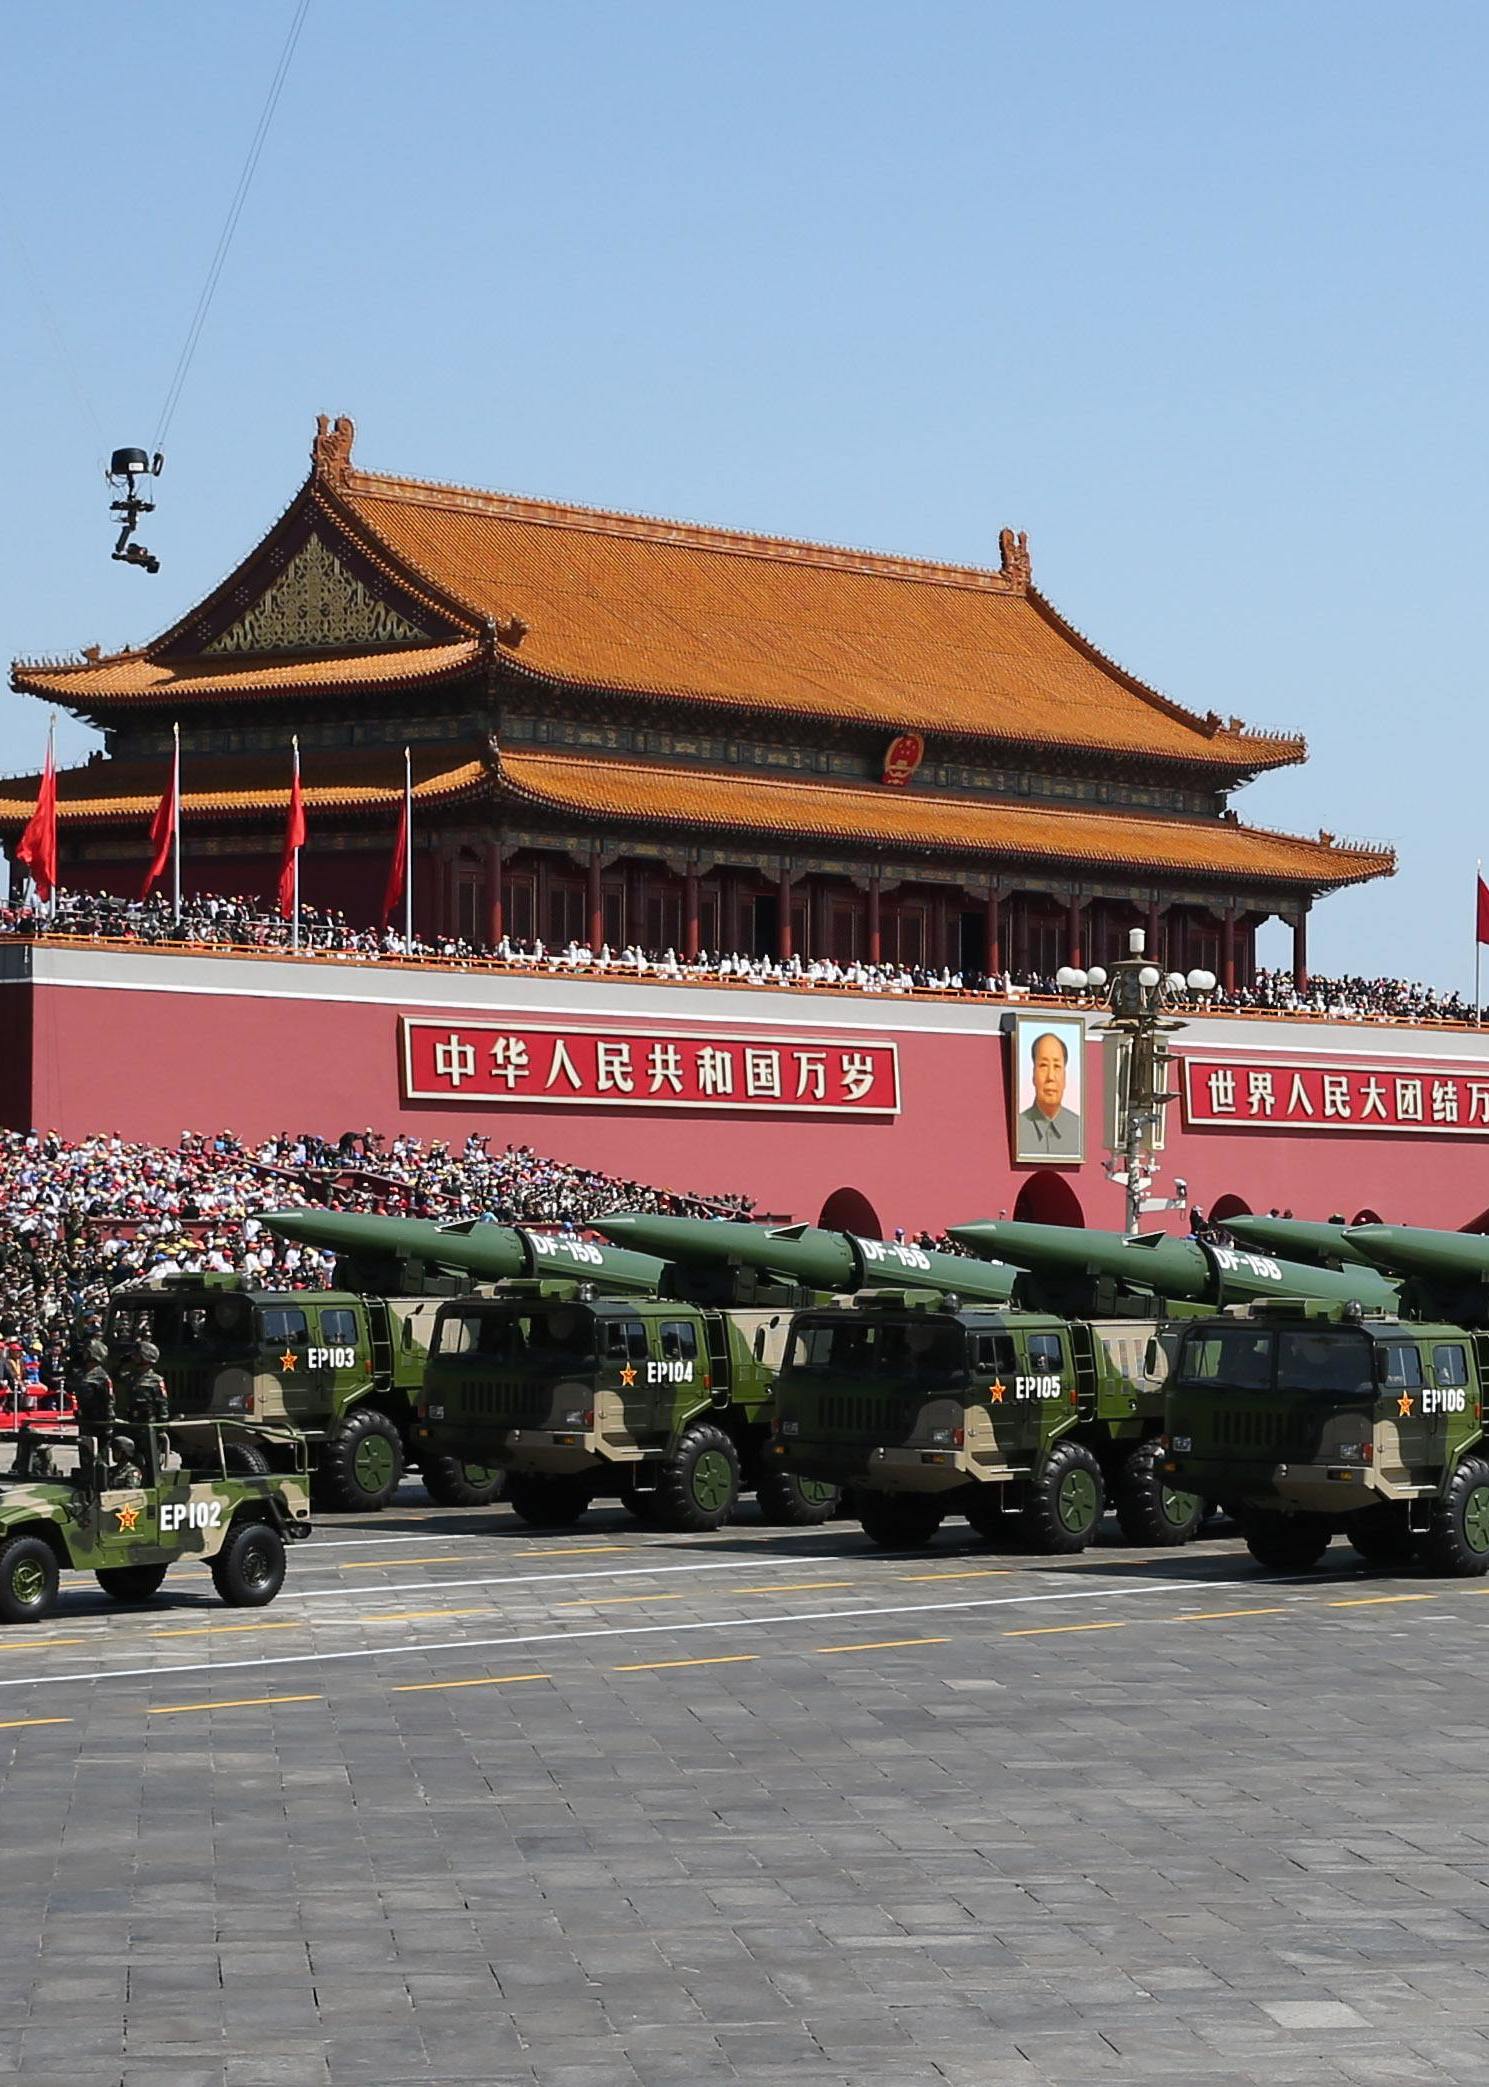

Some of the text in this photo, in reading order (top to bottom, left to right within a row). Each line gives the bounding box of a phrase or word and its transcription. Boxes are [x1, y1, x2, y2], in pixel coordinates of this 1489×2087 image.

[434, 1034, 876, 1101] 中华人民共和国万岁
[528, 1233, 604, 1265] DF-15B
[857, 1238, 931, 1270] DF-15B
[1212, 1247, 1283, 1281] DF-15B
[307, 1347, 355, 1369] EP103
[647, 1360, 693, 1383] EP104
[1015, 1375, 1061, 1399] EP105
[1422, 1388, 1466, 1413] EP106
[160, 1501, 221, 1531] EP102
